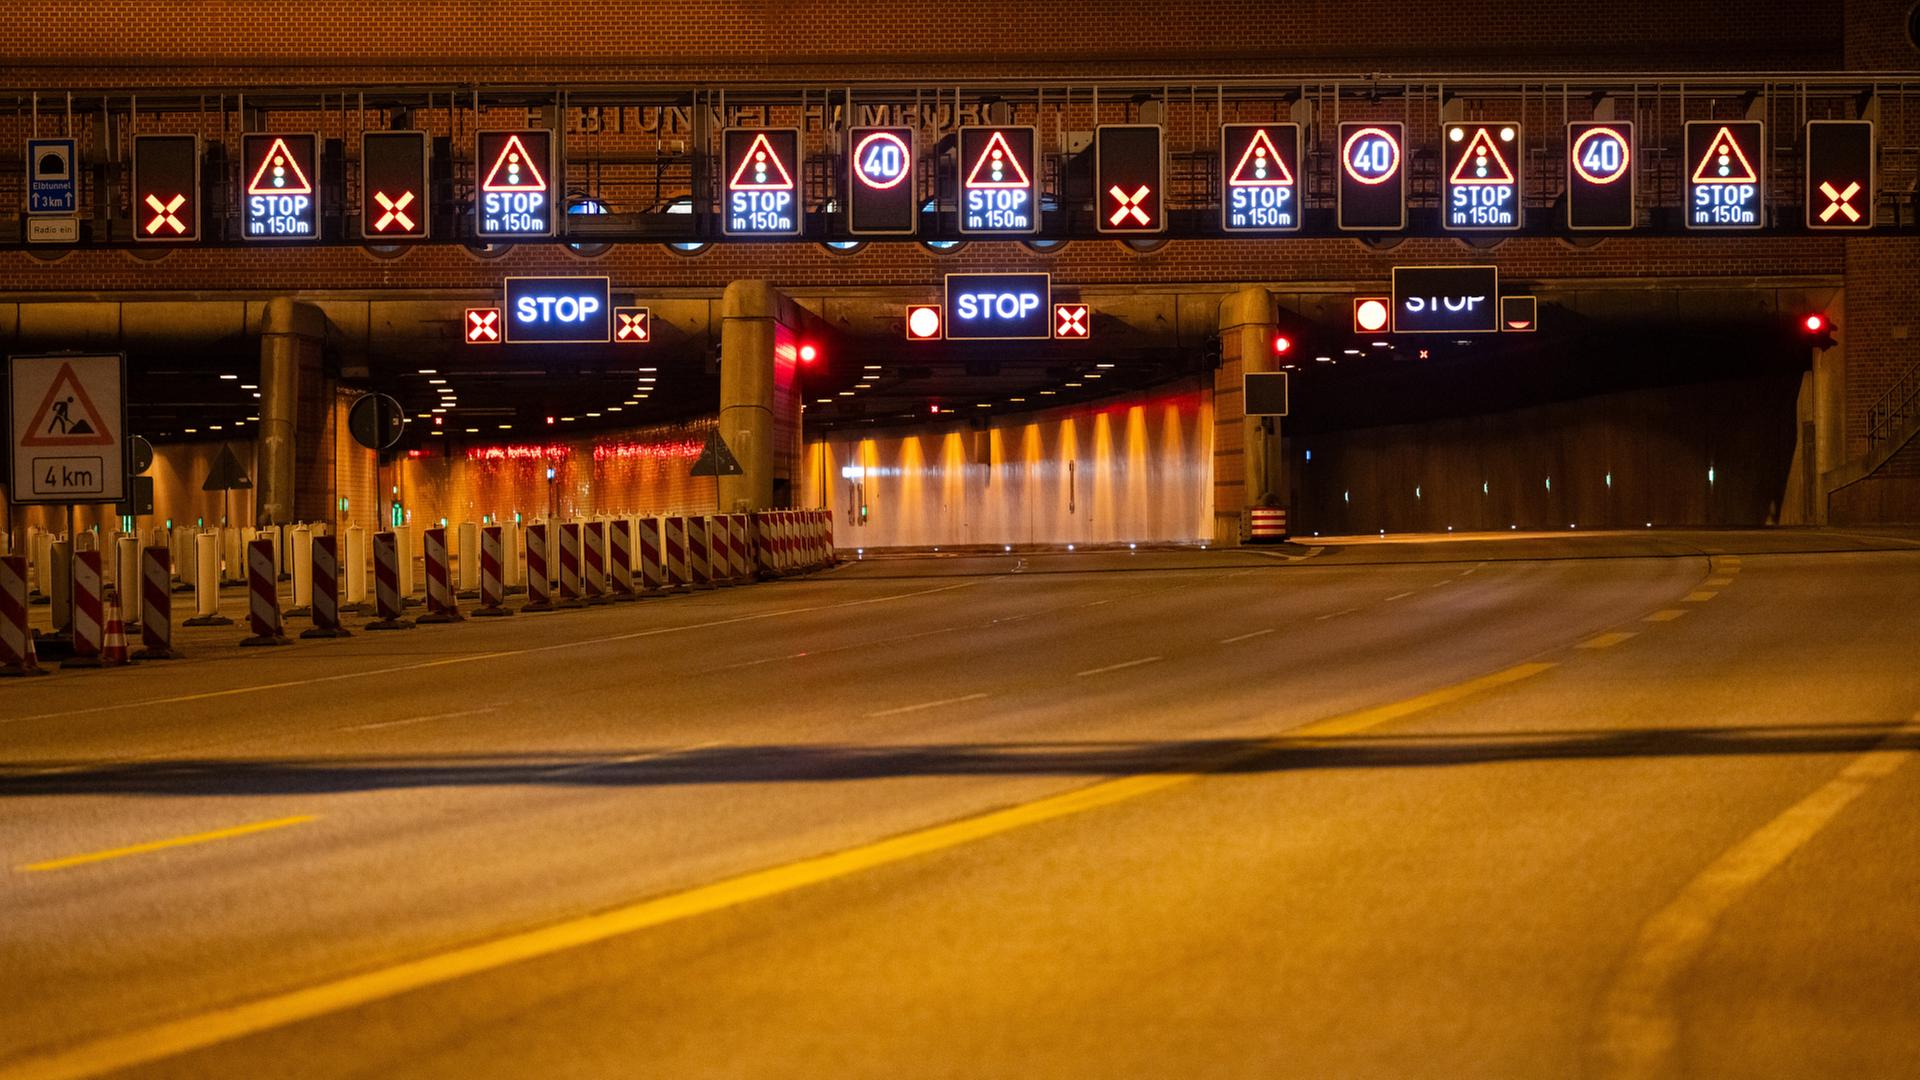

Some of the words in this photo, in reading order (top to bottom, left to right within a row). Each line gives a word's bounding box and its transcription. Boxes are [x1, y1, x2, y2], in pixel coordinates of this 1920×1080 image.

[864, 145, 899, 176] 40
[1353, 141, 1389, 171] 40
[1583, 141, 1618, 171] 40
[32, 181, 71, 190] Elbtunnel
[1695, 185, 1754, 205] STOP
[251, 195, 308, 216] STOP
[486, 192, 543, 213] STOP
[733, 191, 790, 212] STOP
[969, 189, 1027, 210] STOP
[1233, 187, 1290, 208] STOP
[1453, 186, 1511, 206] STOP
[486, 214, 499, 231] in
[733, 213, 746, 229] in
[969, 211, 982, 227] in
[1233, 209, 1246, 225] in
[1453, 208, 1466, 224] in
[1696, 206, 1709, 223] in
[34, 226, 57, 234] Radio
[251, 217, 264, 234] in
[517, 296, 599, 323] STOP
[958, 293, 1039, 319] STOP
[45, 466, 56, 486] 4
[63, 466, 92, 486] km
